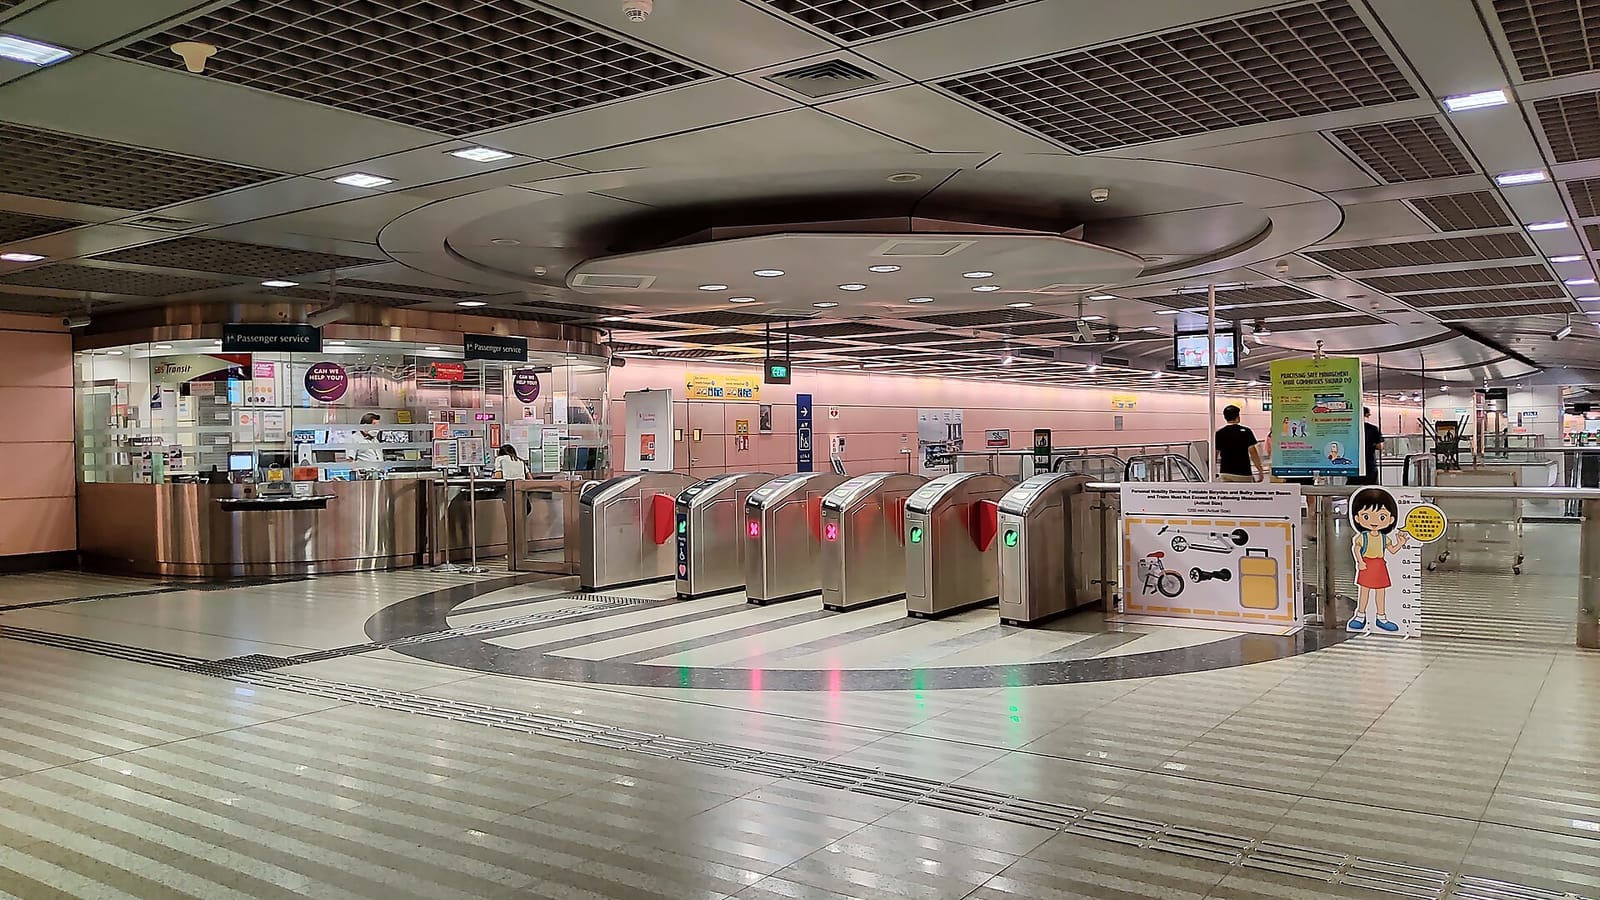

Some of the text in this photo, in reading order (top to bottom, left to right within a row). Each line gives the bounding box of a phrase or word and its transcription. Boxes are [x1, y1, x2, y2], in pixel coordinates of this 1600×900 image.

[237, 335, 310, 343] Passenger service
[474, 344, 501, 353] Passenger
[164, 363, 192, 374] Transit
